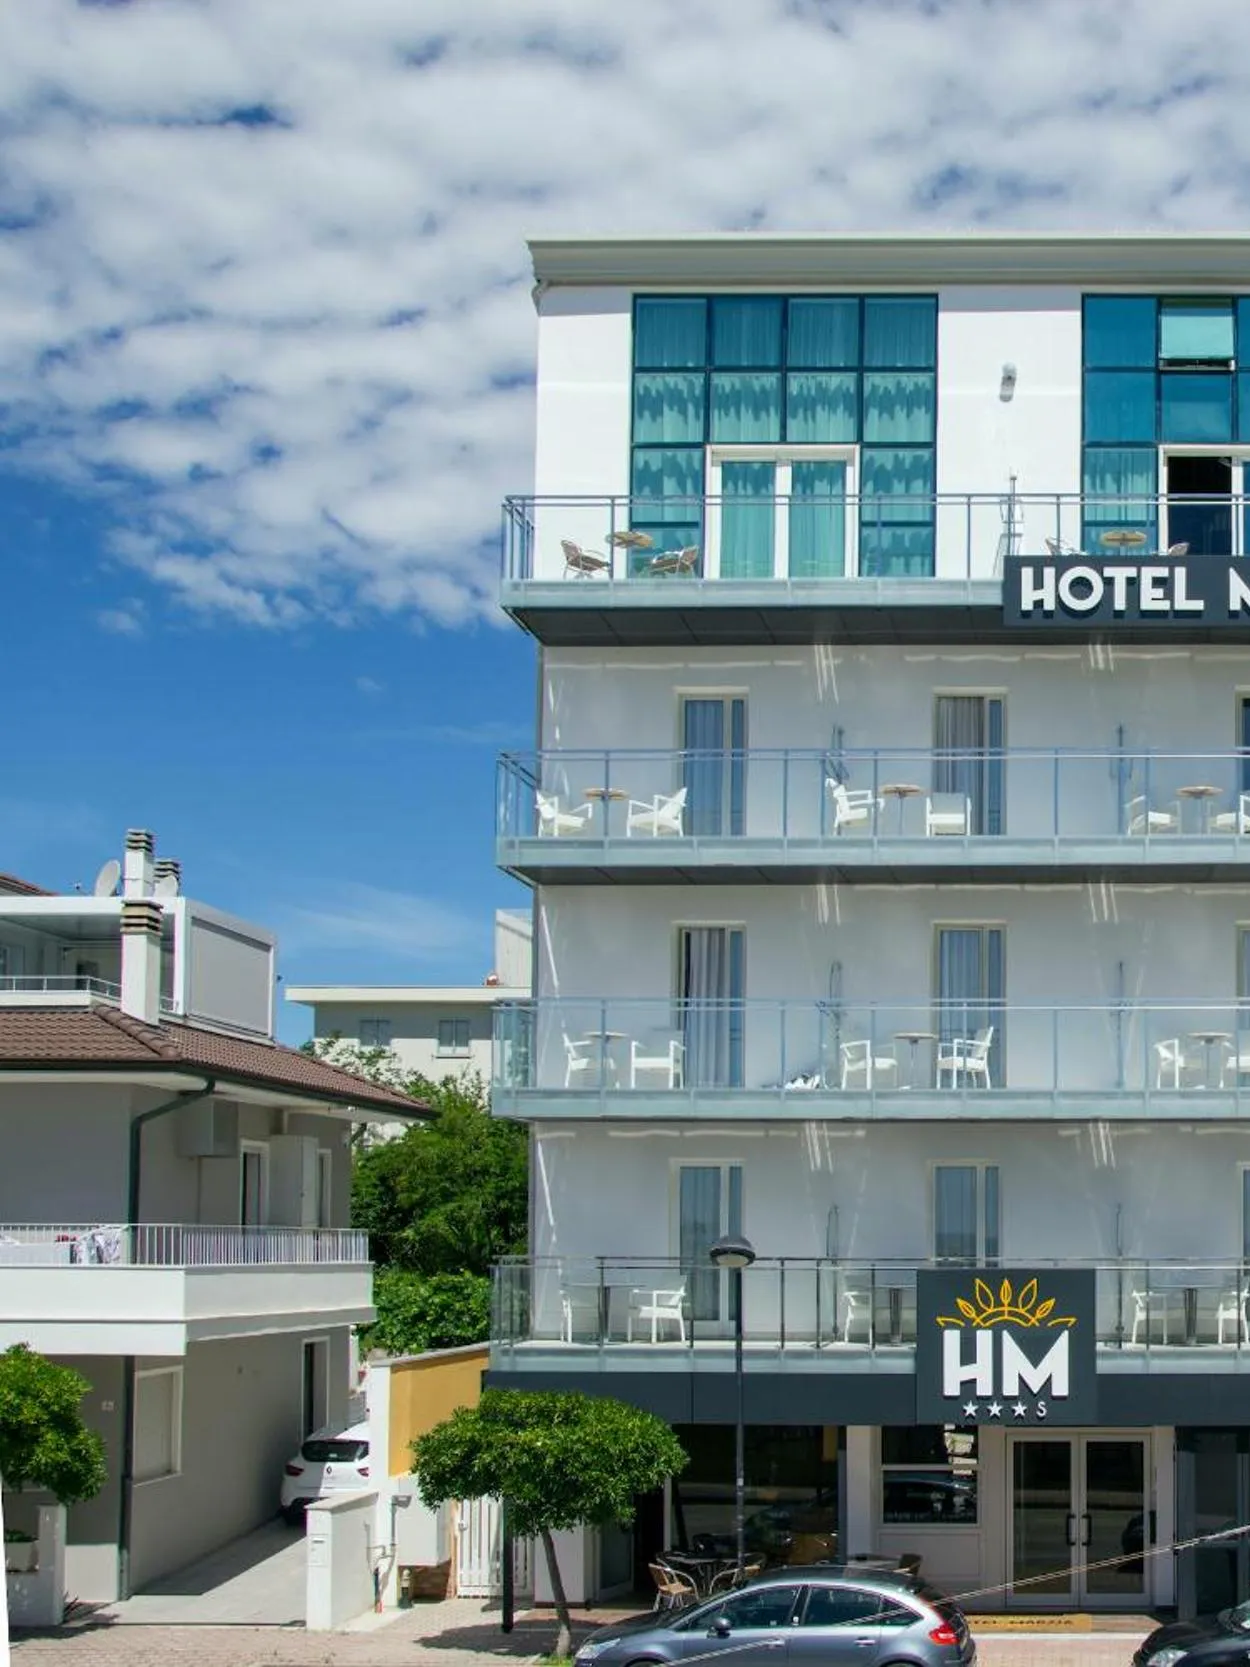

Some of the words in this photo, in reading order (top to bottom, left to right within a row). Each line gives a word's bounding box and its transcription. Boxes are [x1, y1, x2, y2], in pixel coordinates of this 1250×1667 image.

[1020, 566, 1204, 611] HOTEL
[943, 1329, 1069, 1397] HM
[1036, 1401, 1047, 1417] S
